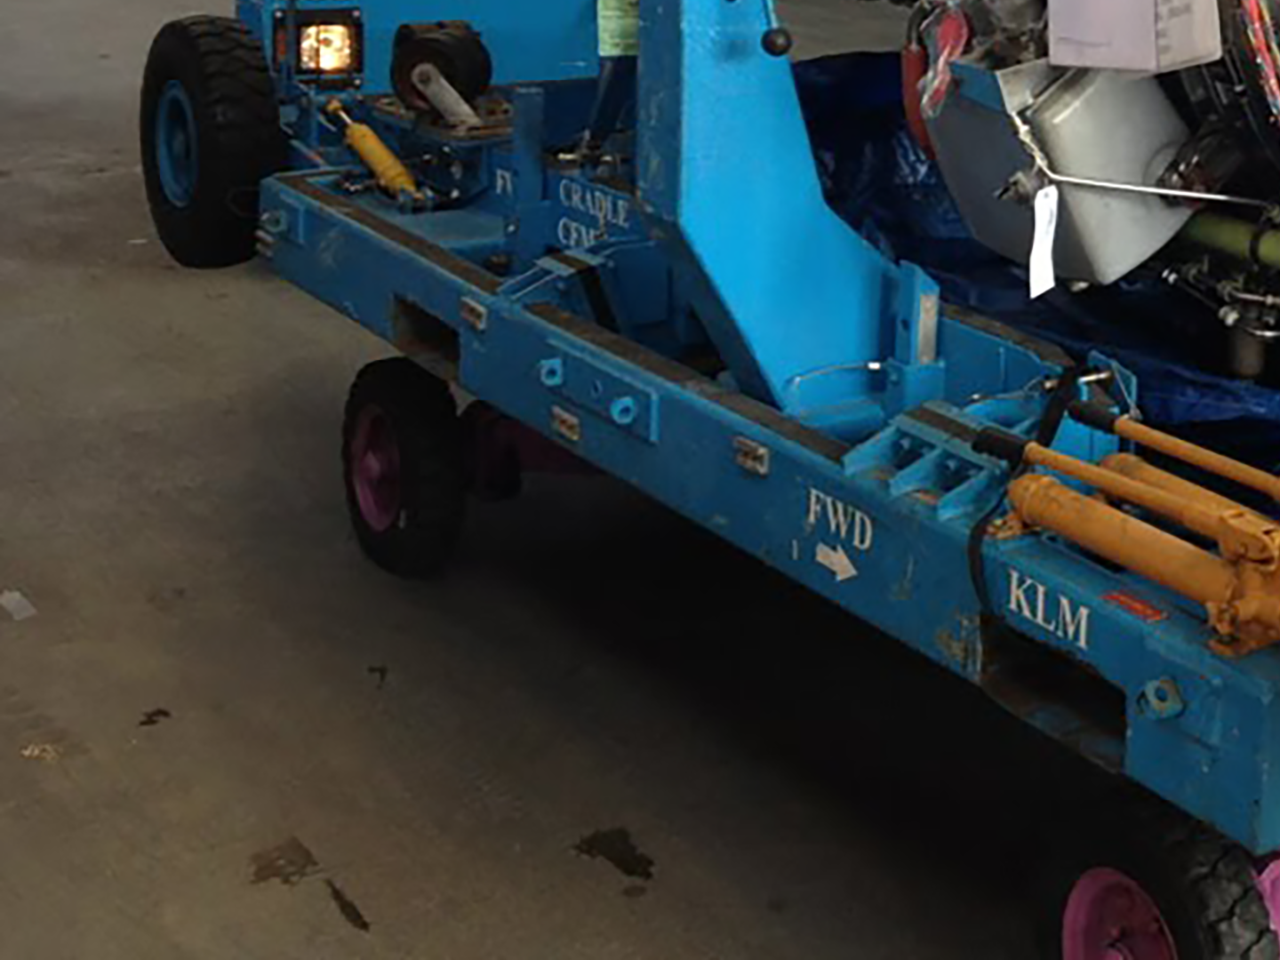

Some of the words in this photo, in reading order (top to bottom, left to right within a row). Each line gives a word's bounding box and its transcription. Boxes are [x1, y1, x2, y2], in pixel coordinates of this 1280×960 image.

[559, 178, 630, 229] CRADLE
[806, 487, 873, 551] FWD
[1007, 568, 1091, 651] KLM
